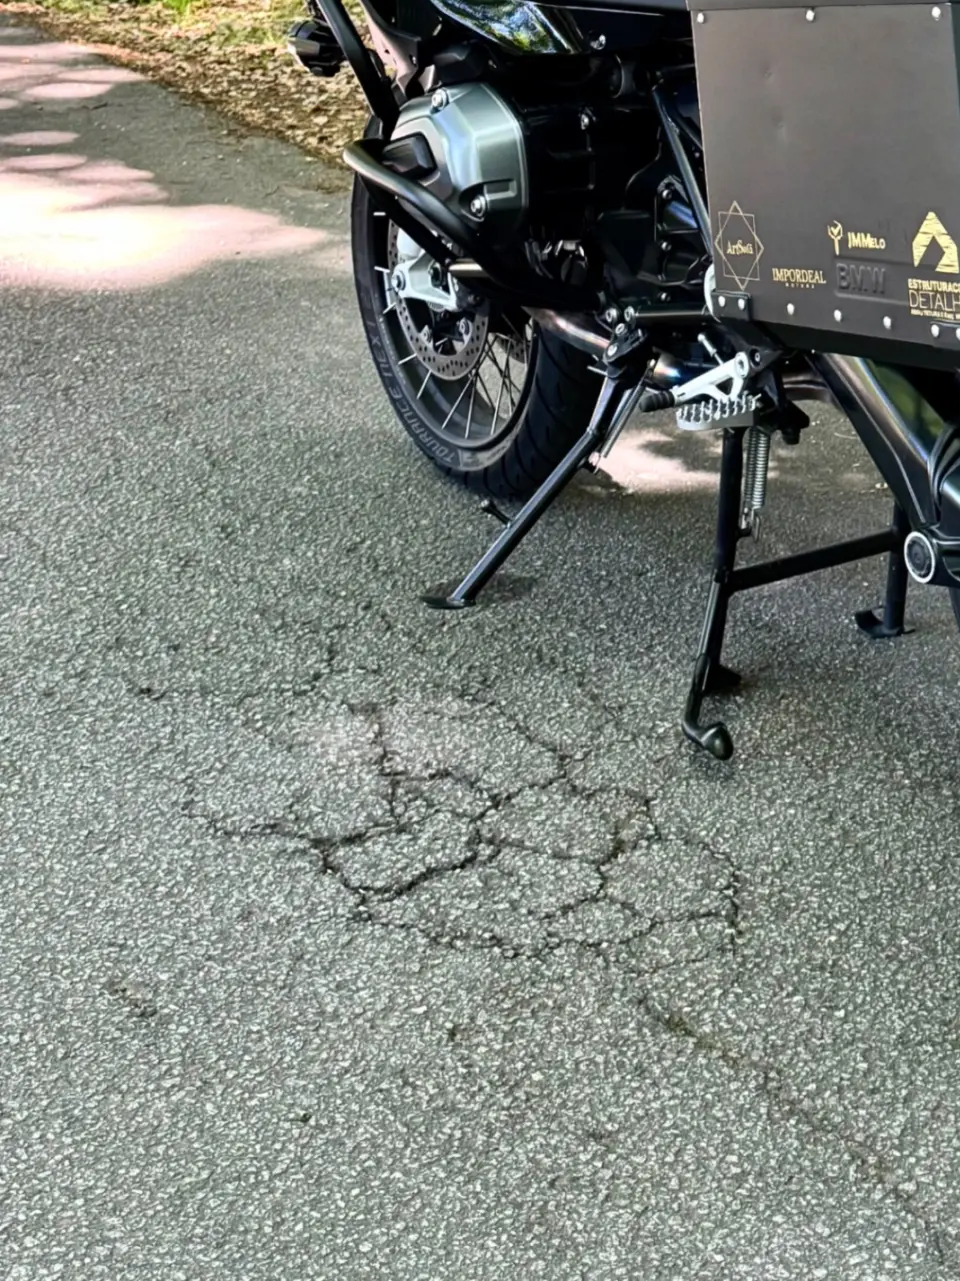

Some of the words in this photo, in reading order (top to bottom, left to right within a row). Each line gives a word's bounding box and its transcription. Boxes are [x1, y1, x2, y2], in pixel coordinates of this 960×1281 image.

[772, 267, 827, 284] IMPORDEAL
[836, 263, 887, 295] BMW
[388, 383, 457, 464] TOURANCE
